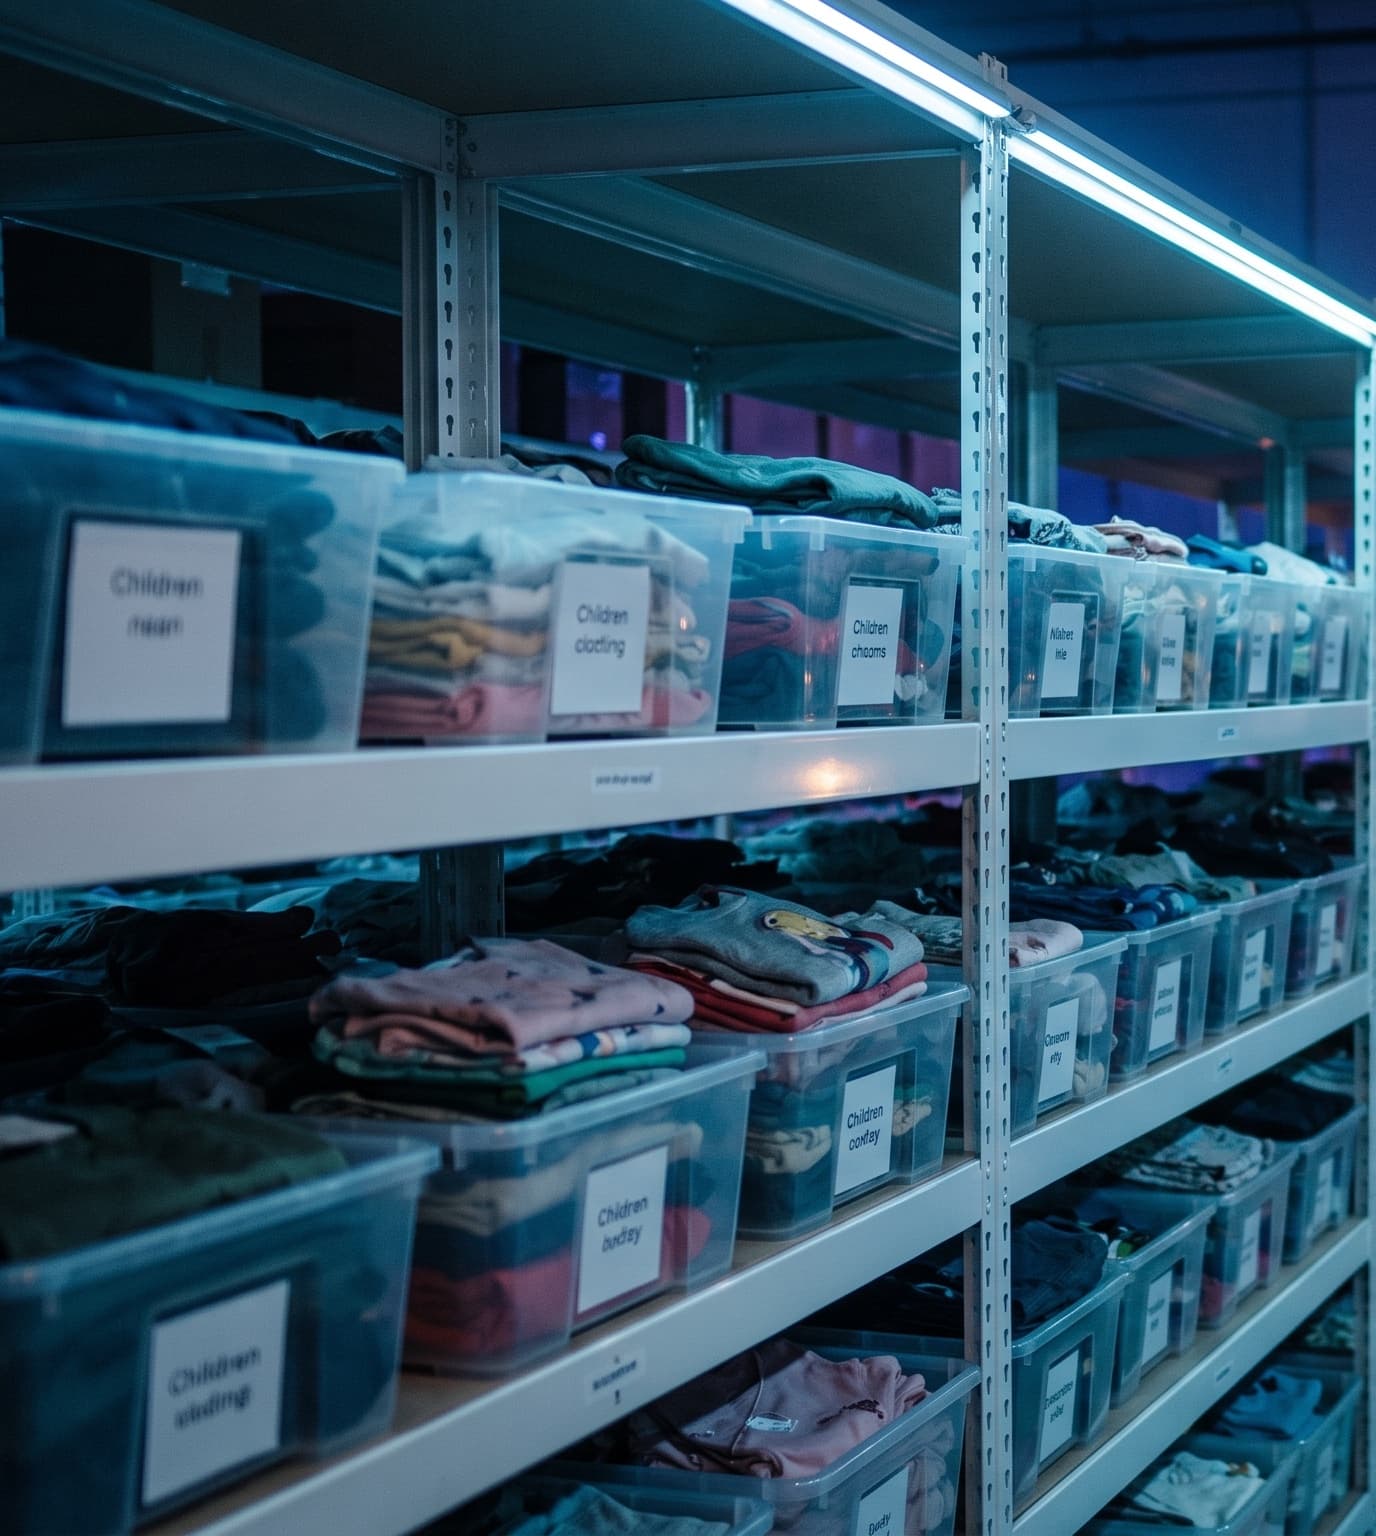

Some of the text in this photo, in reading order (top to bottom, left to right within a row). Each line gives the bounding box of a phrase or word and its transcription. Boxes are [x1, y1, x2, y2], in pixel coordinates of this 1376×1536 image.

[109, 566, 204, 597] Children
[576, 603, 628, 625] Children
[853, 618, 889, 635] Children
[846, 1104, 884, 1129] Children
[597, 1194, 648, 1228] Children
[167, 1345, 262, 1398] Children
